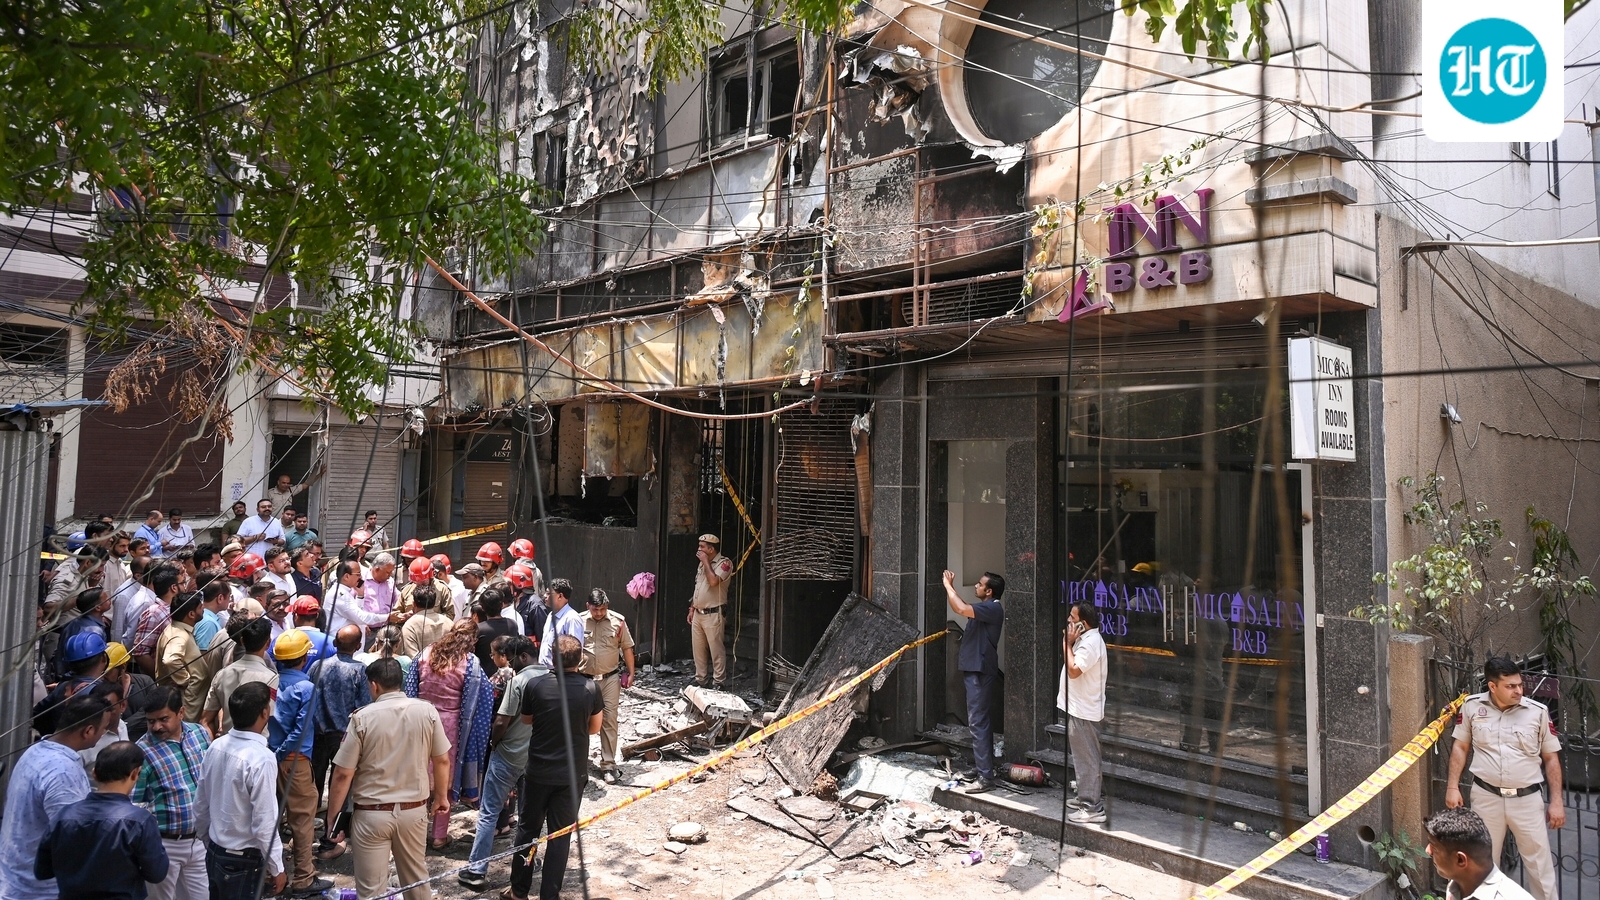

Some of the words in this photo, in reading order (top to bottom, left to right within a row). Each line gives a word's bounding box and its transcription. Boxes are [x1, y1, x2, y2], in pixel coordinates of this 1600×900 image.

[1102, 187, 1216, 260] INN
[1105, 251, 1214, 294] B&B
[1327, 383, 1343, 403] INN
[1324, 408, 1348, 428] ROOMS
[1320, 431, 1354, 451] AVAILABLE
[1231, 627, 1268, 655] B&B
